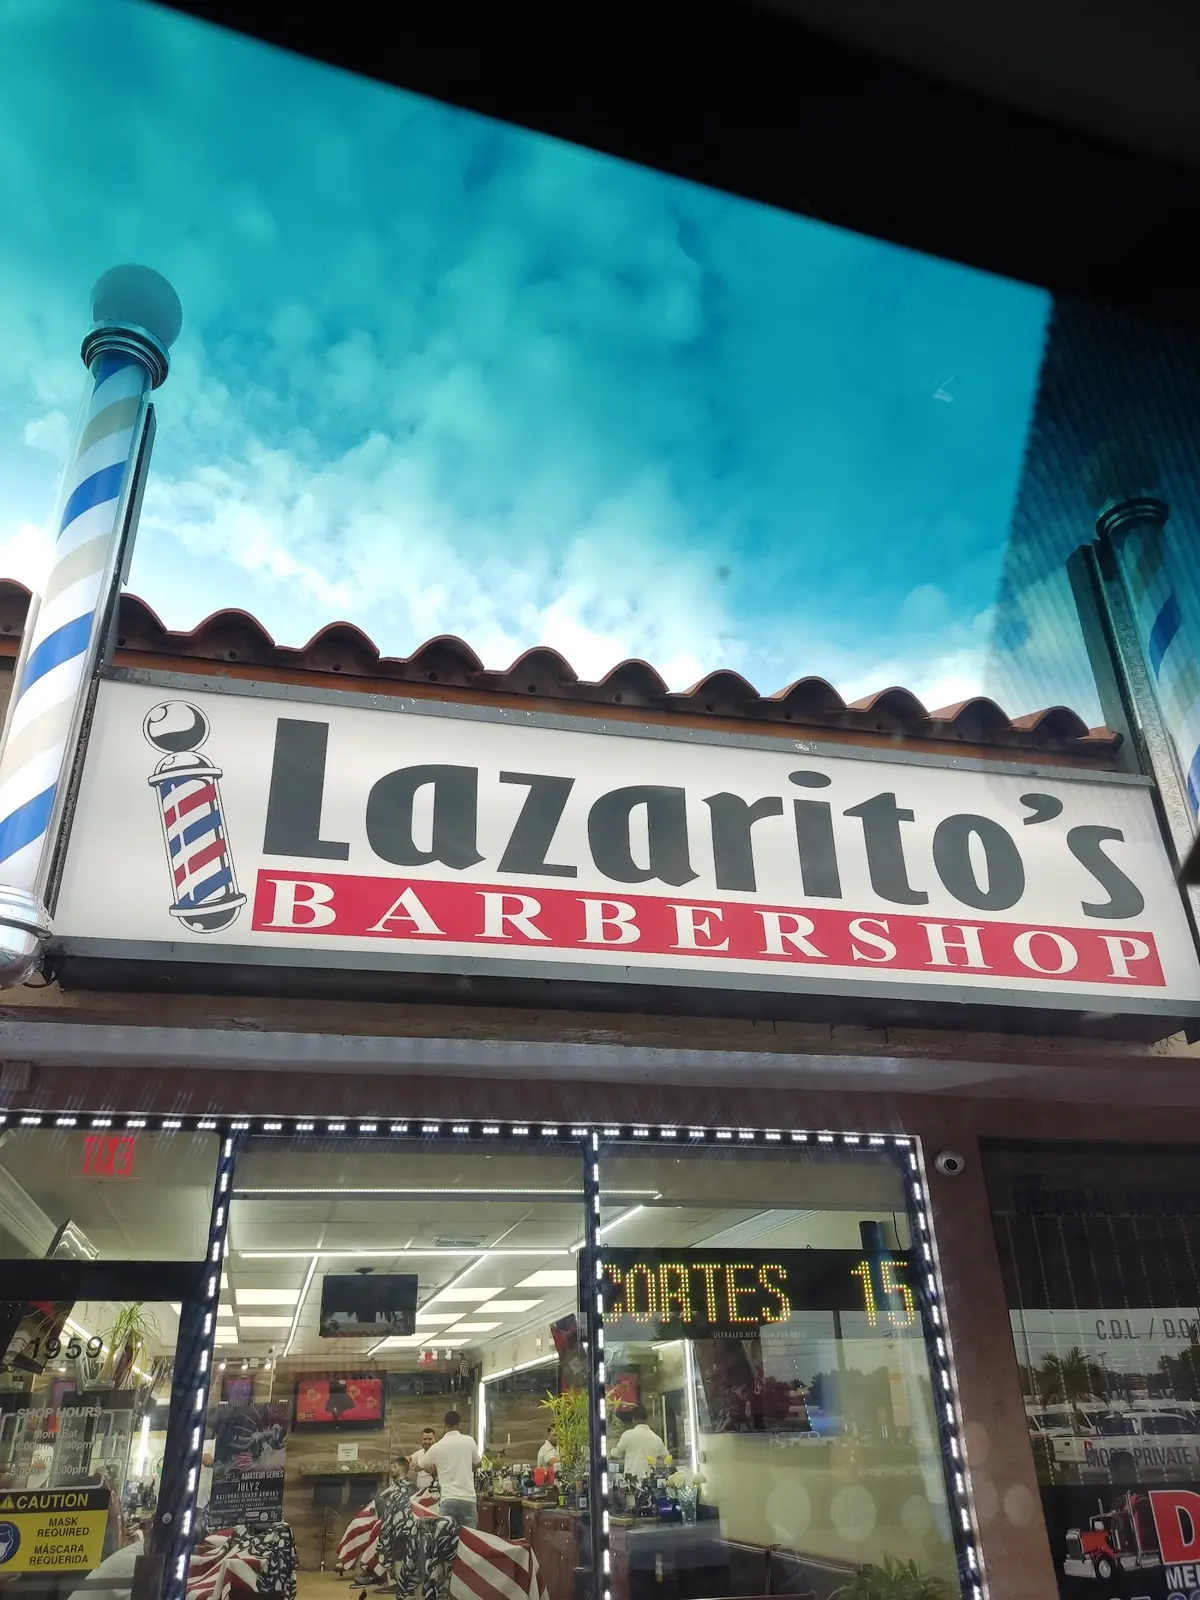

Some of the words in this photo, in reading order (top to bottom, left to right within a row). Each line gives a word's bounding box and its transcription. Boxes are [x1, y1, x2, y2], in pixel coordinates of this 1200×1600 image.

[263, 718, 1145, 919] Lazarito's
[261, 878, 1151, 980] BARBERSHOP
[850, 1261, 916, 1327] 15
[29, 1336, 103, 1359] 1959
[18, 1407, 54, 1419] SHOP
[56, 1406, 103, 1418] HOURS
[33, 1453, 70, 1463] Sunay
[1133, 1446, 1193, 1467] PRIVATE
[241, 1471, 266, 1480] AMATEUR
[266, 1470, 284, 1479] SERIES
[237, 1481, 254, 1491] JULY
[254, 1481, 260, 1490] 2
[16, 1493, 89, 1510] CAUTION
[49, 1516, 78, 1527] MASK
[37, 1527, 89, 1538] REQUIRED
[33, 1543, 84, 1555] MÁSCARA
[29, 1554, 88, 1566] REQUERIDA
